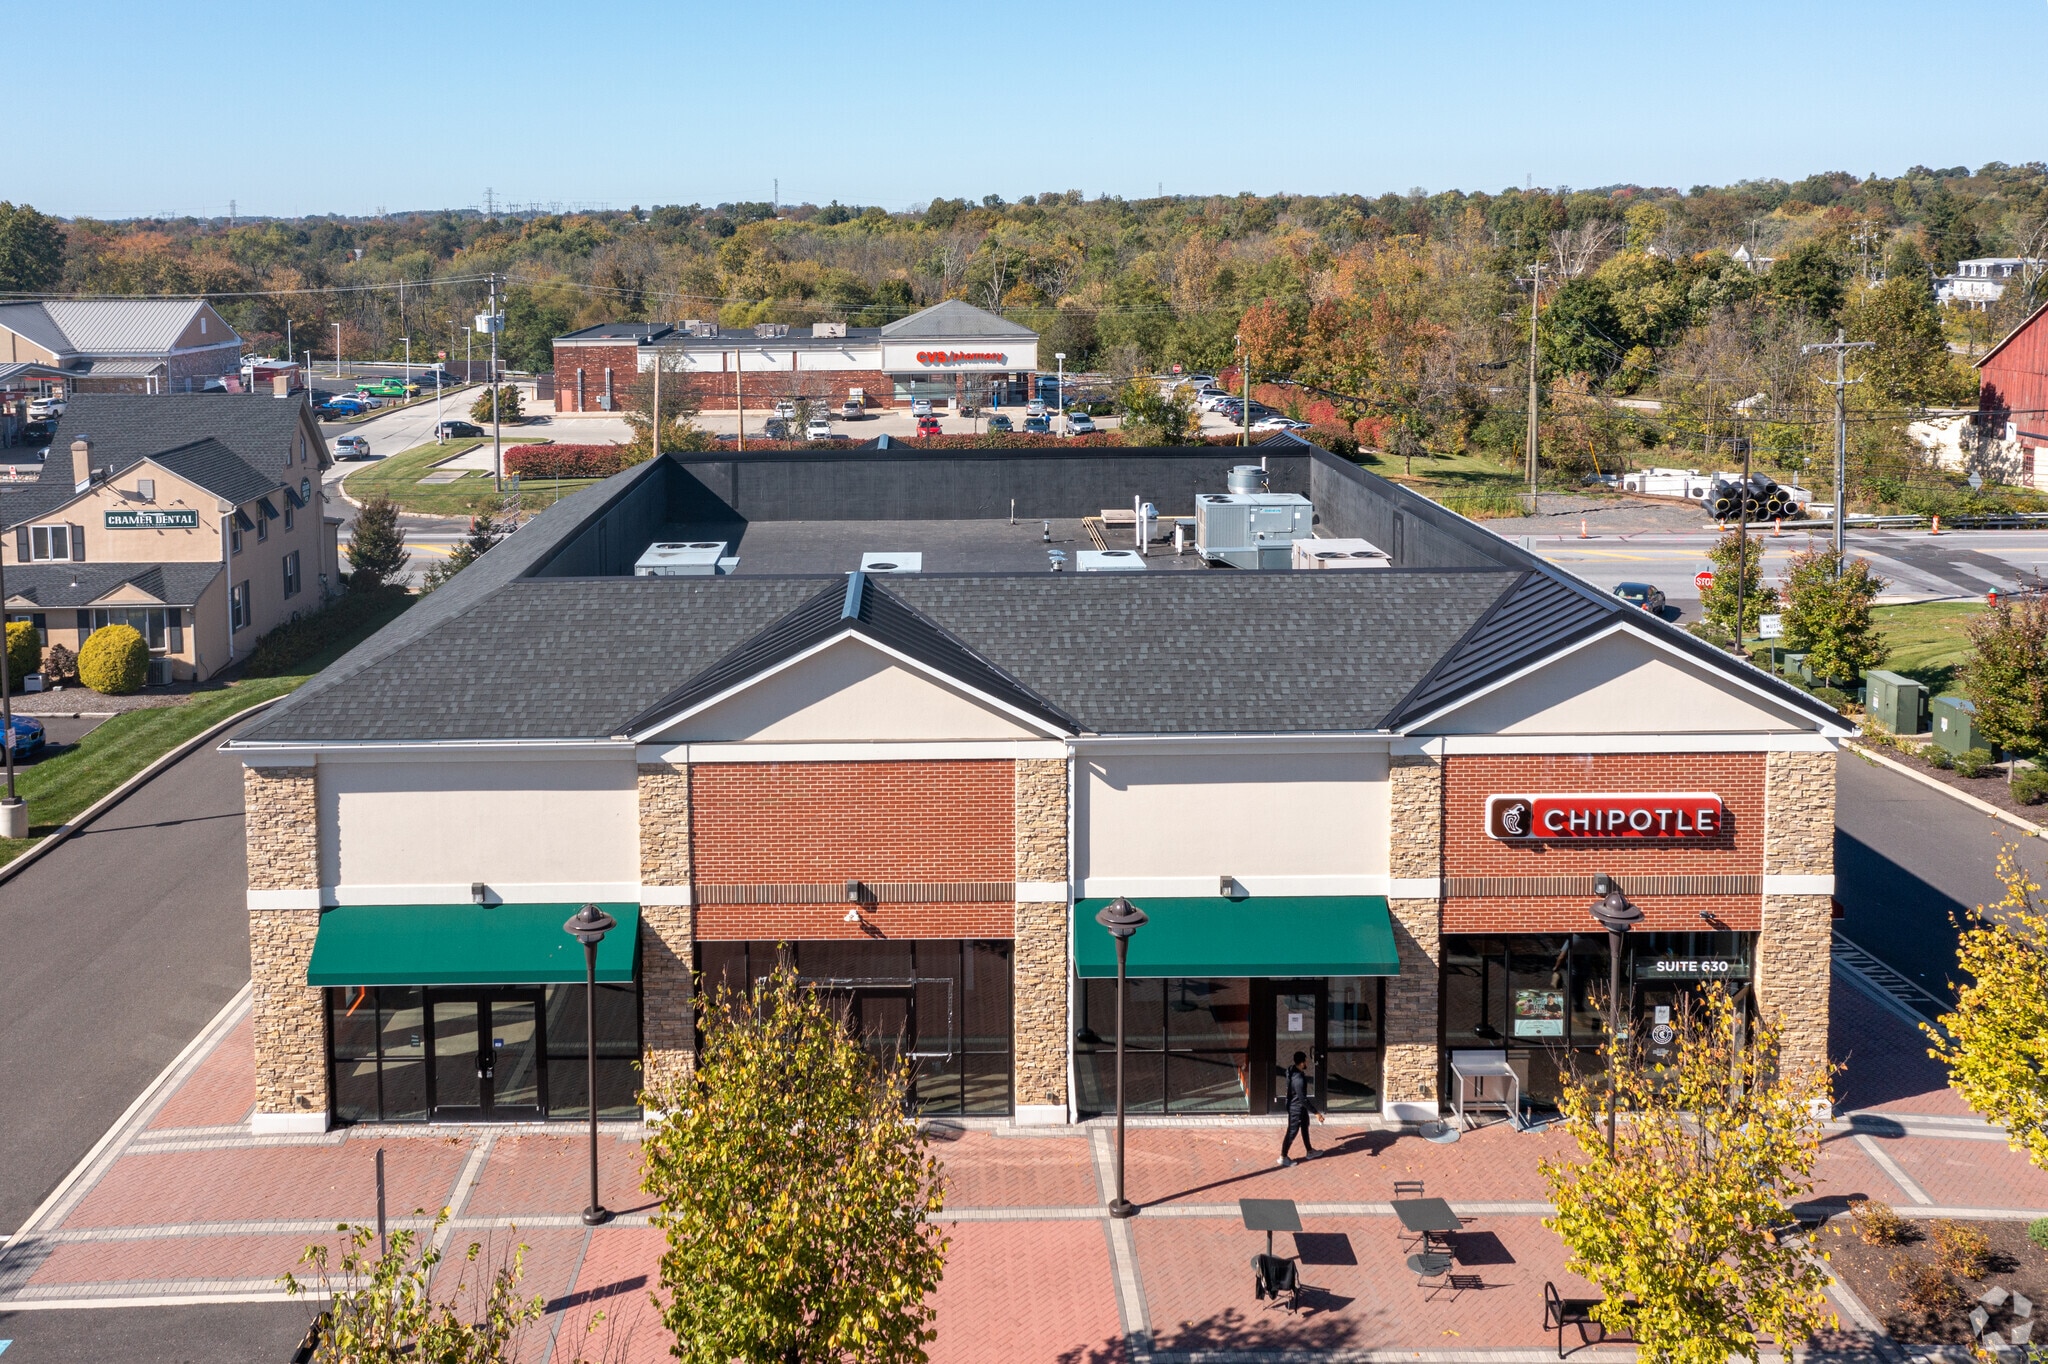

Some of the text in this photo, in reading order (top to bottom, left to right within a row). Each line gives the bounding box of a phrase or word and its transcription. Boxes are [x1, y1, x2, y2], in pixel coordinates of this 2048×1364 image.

[108, 514, 194, 525] CRAMER DENTAL
[1544, 808, 1715, 831] CHIPOTLE
[1656, 961, 1729, 972] SUITE 630
